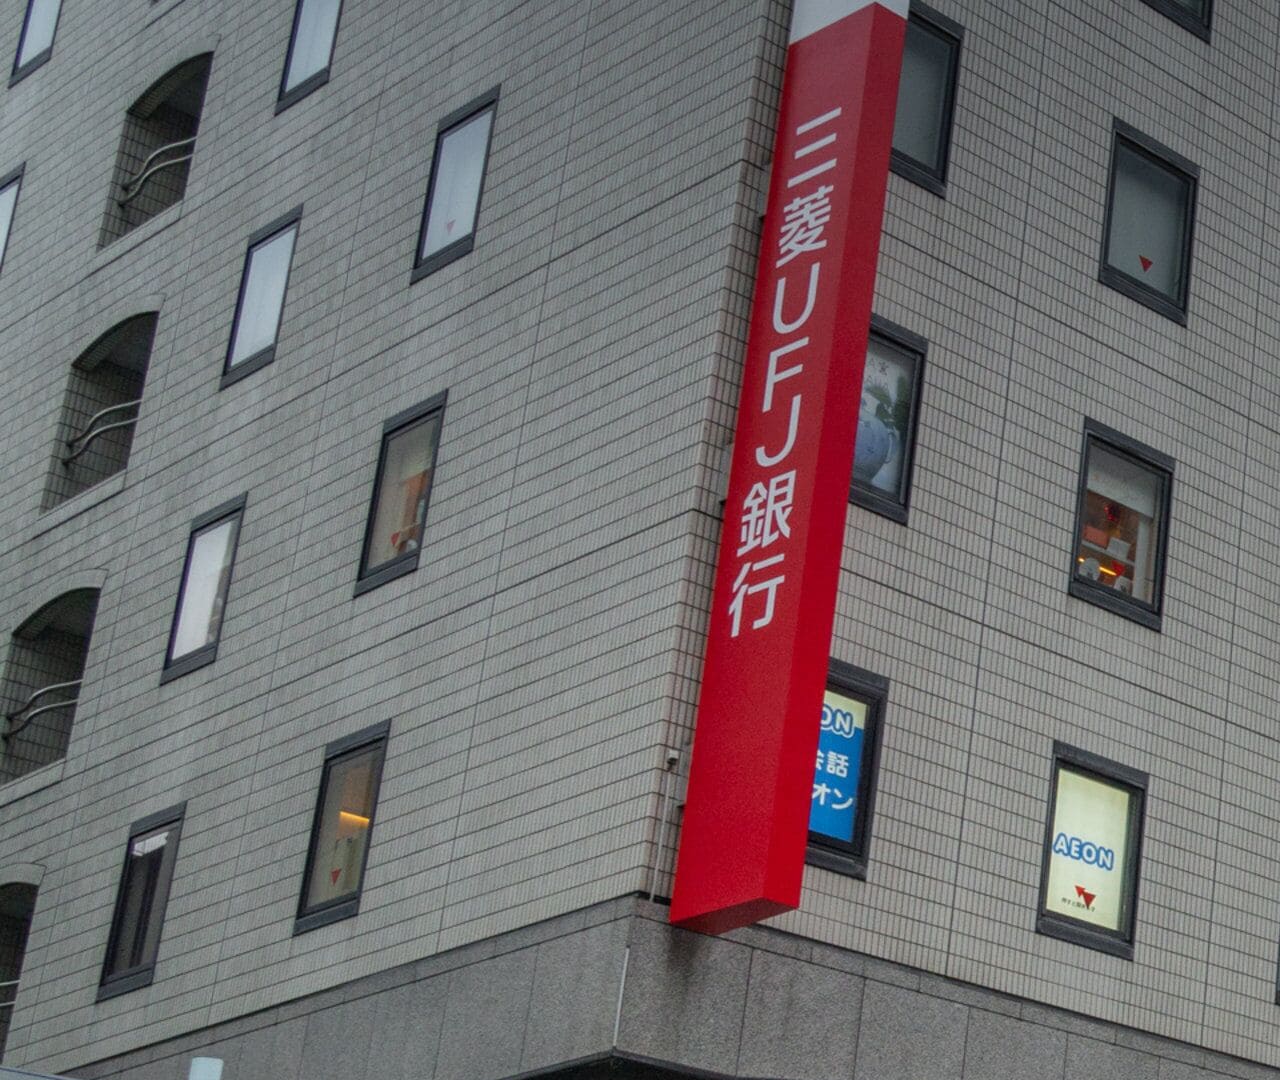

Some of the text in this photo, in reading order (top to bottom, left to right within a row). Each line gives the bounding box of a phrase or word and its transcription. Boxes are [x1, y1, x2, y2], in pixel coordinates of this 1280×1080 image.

[729, 107, 842, 638] 三菱UFJ銀行
[1053, 833, 1115, 871] AEON
